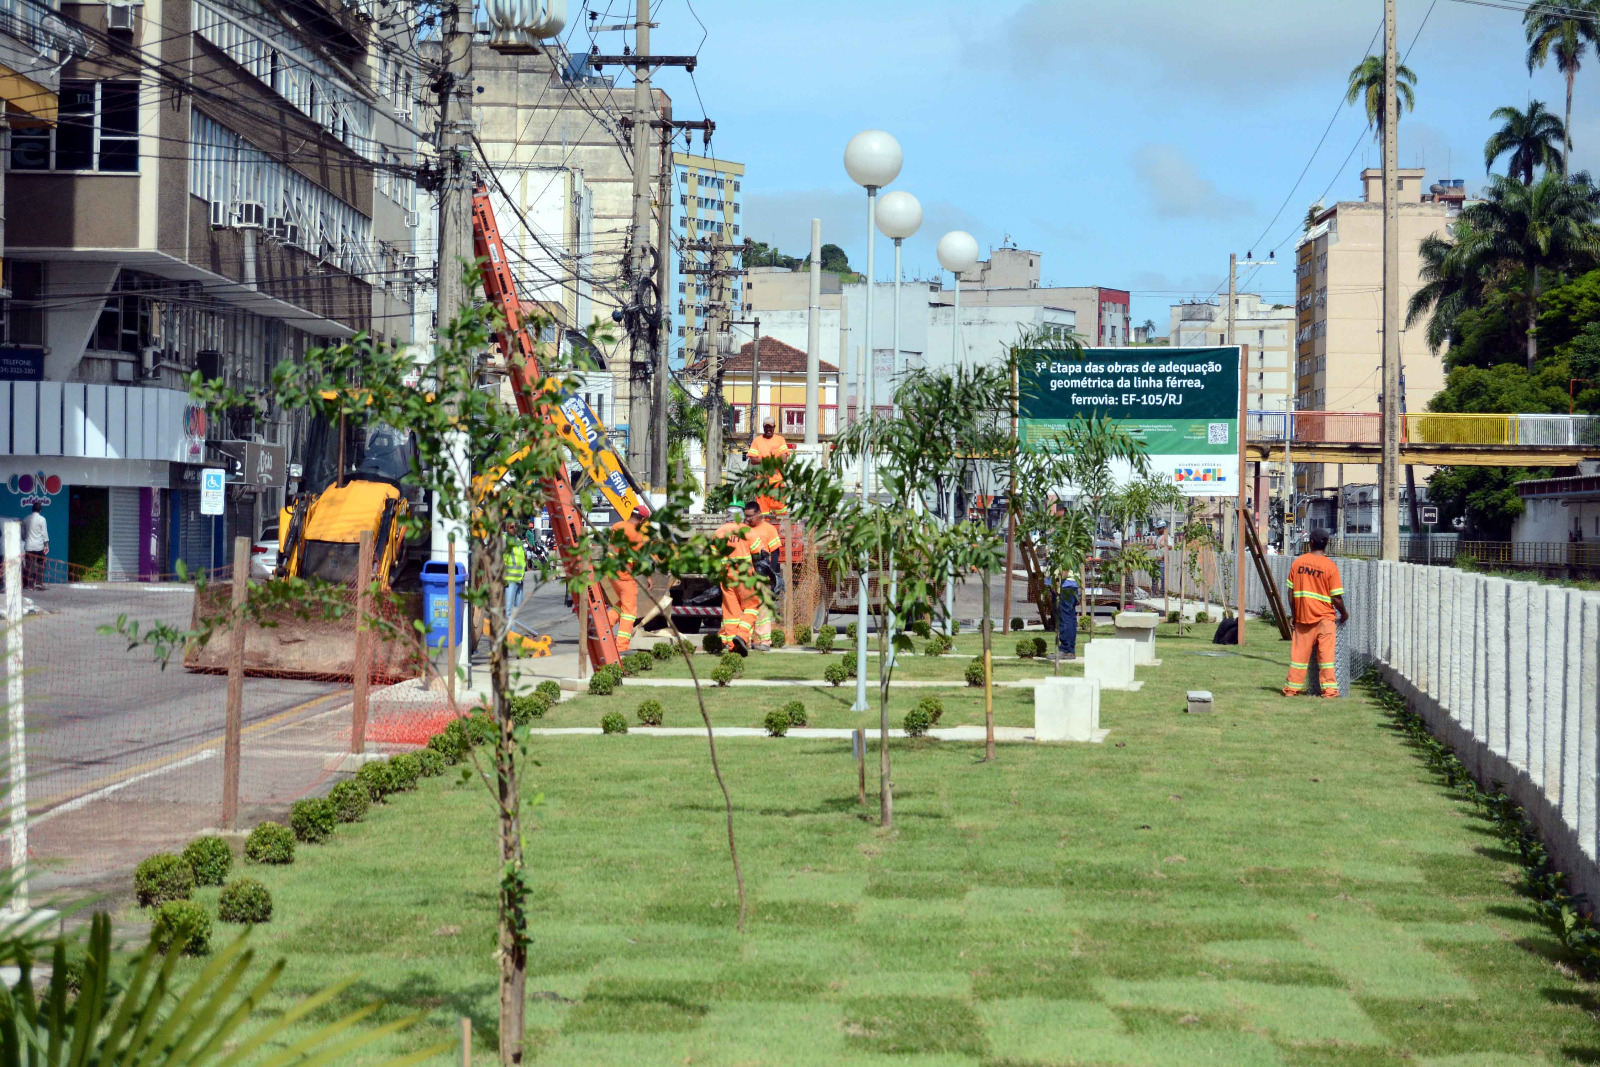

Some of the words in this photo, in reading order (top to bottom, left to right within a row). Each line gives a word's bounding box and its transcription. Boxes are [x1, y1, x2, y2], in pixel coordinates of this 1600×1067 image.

[1049, 361, 1082, 376] Etapa
[1084, 361, 1105, 373] das
[1106, 361, 1139, 373] obras
[1141, 361, 1156, 373] de
[1158, 360, 1222, 376] adequação
[1049, 376, 1114, 391] geométrica
[1116, 376, 1131, 388] da
[1133, 376, 1163, 388] linha
[1165, 375, 1205, 390] férrea,
[1070, 392, 1119, 405] ferrovia:
[1121, 392, 1183, 407] EF-105/RJ
[1174, 468, 1227, 482] BRASIL
[1297, 565, 1324, 578] DNIT
